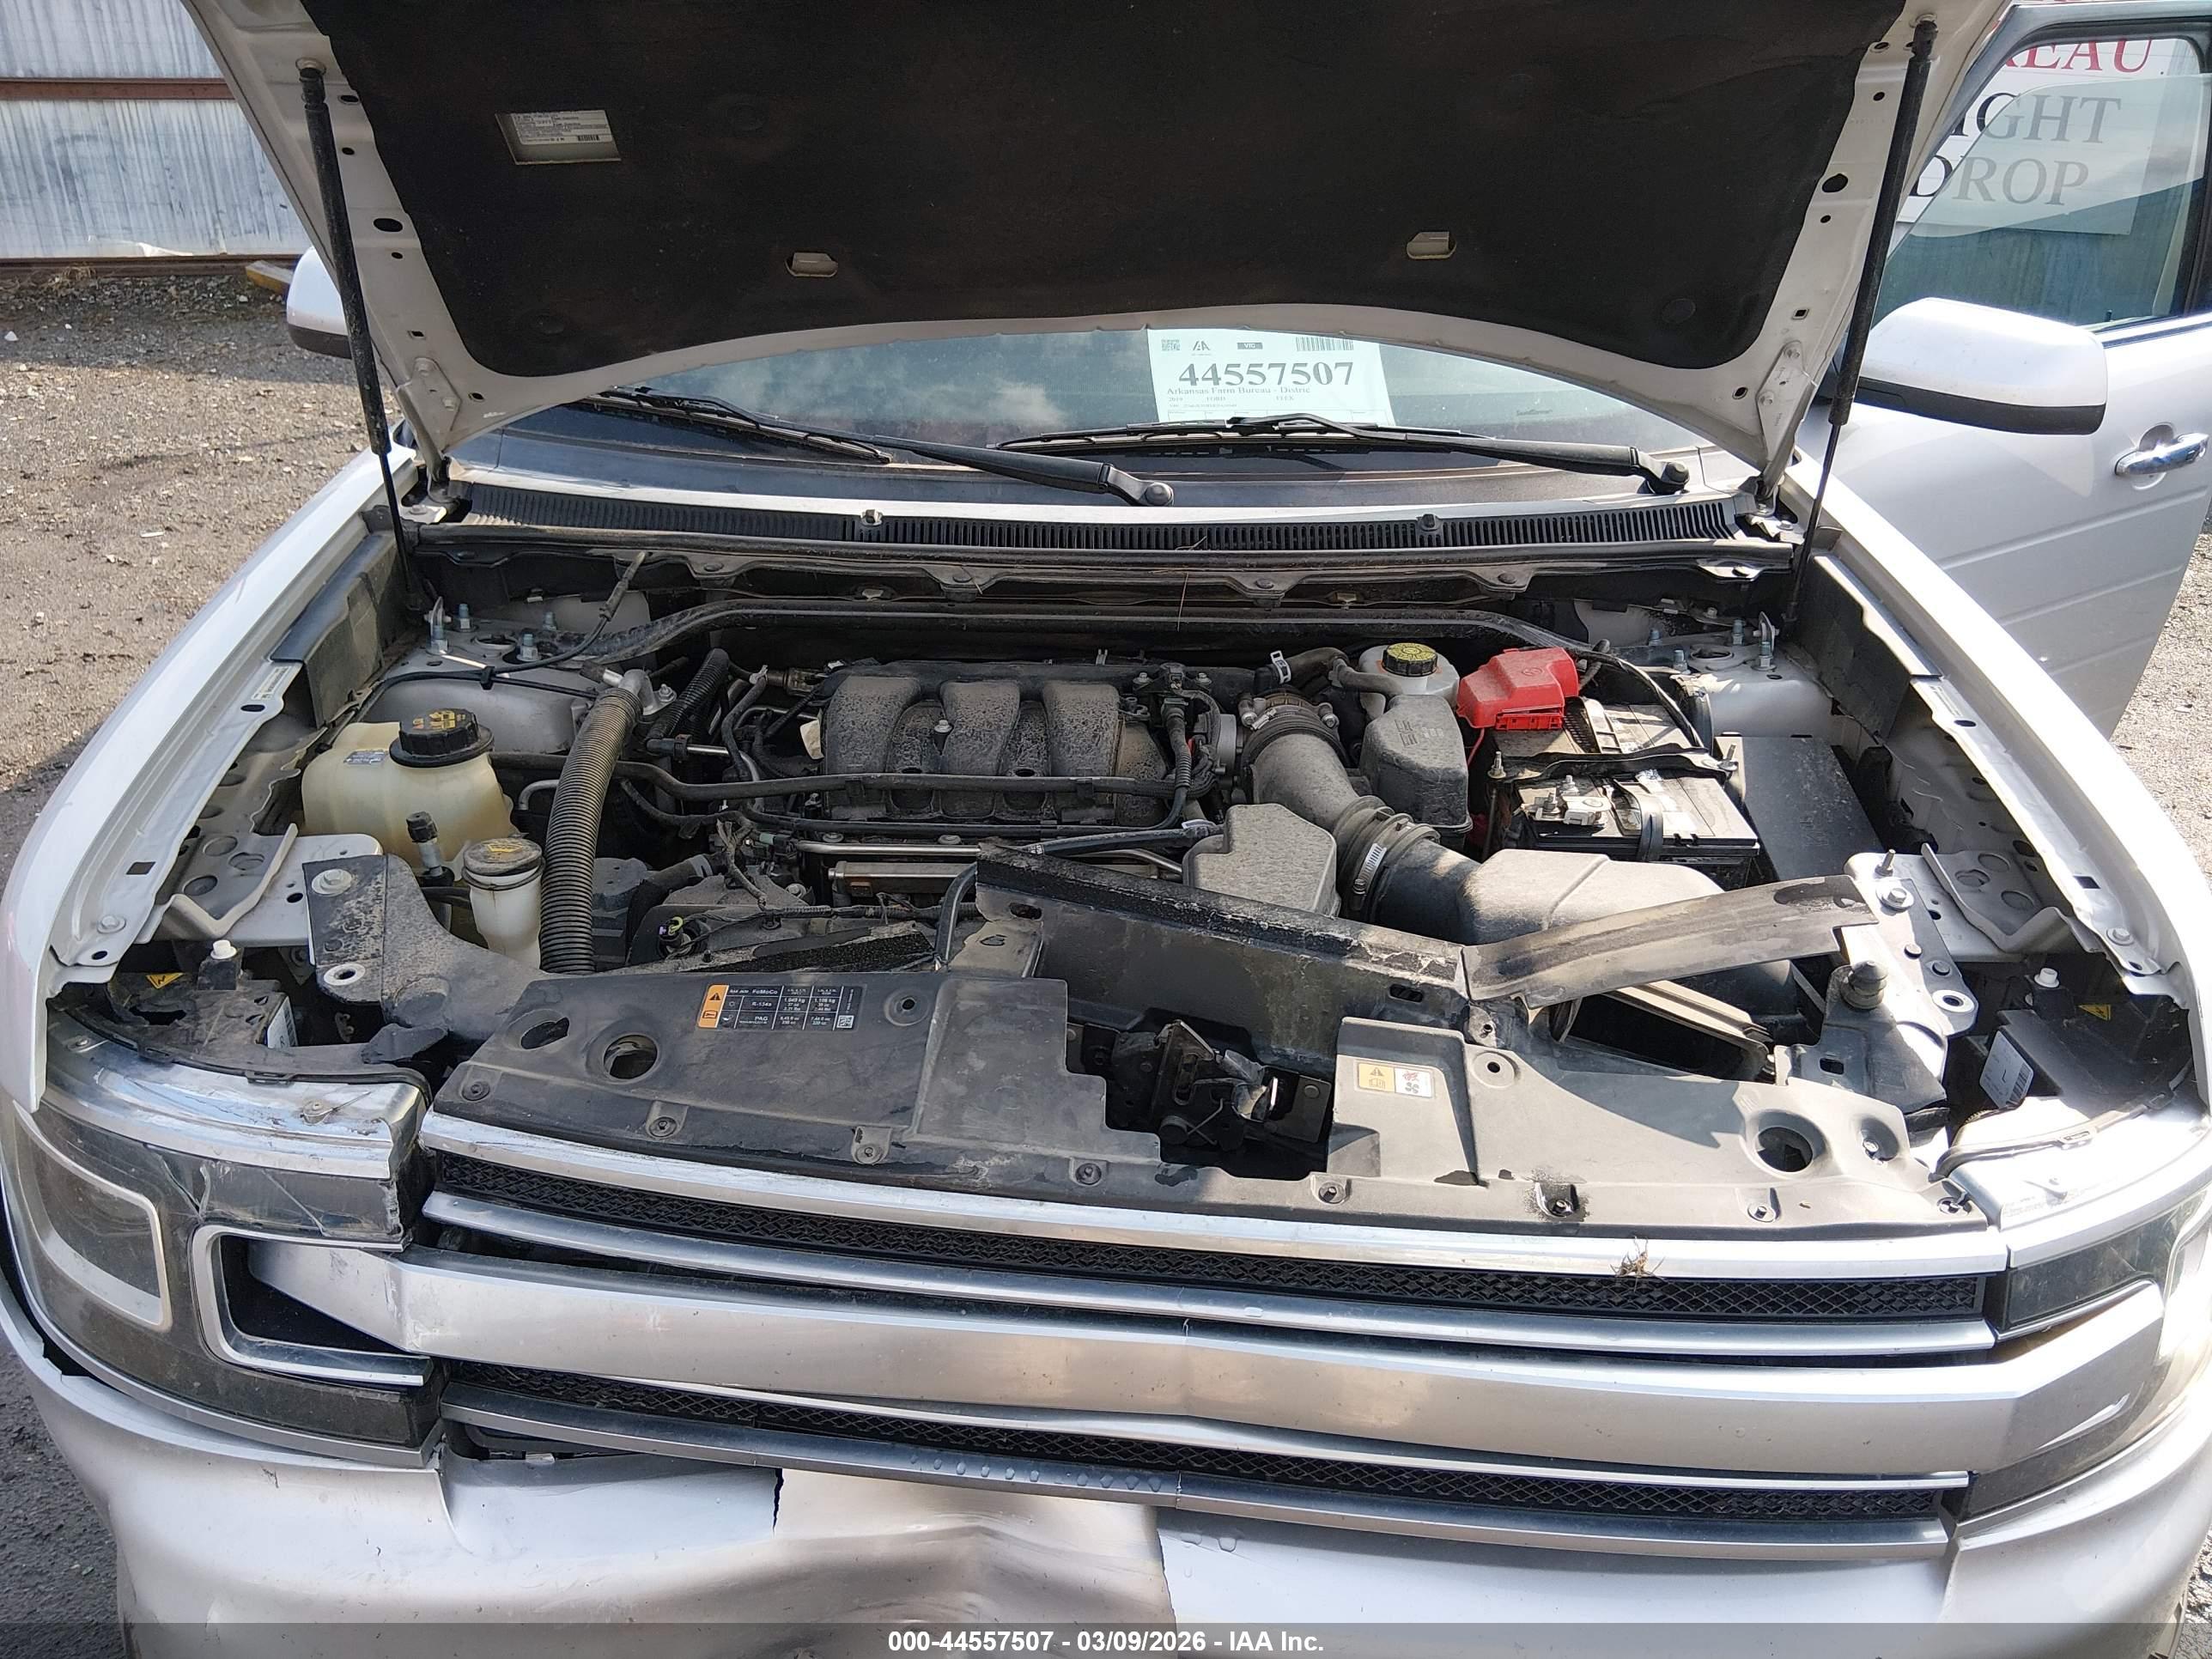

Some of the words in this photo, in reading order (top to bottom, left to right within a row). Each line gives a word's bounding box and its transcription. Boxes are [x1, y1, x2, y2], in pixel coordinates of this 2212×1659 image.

[2005, 38, 2152, 72] EAU
[1909, 155, 2089, 205] DROP
[1179, 362, 1354, 386] 44557507
